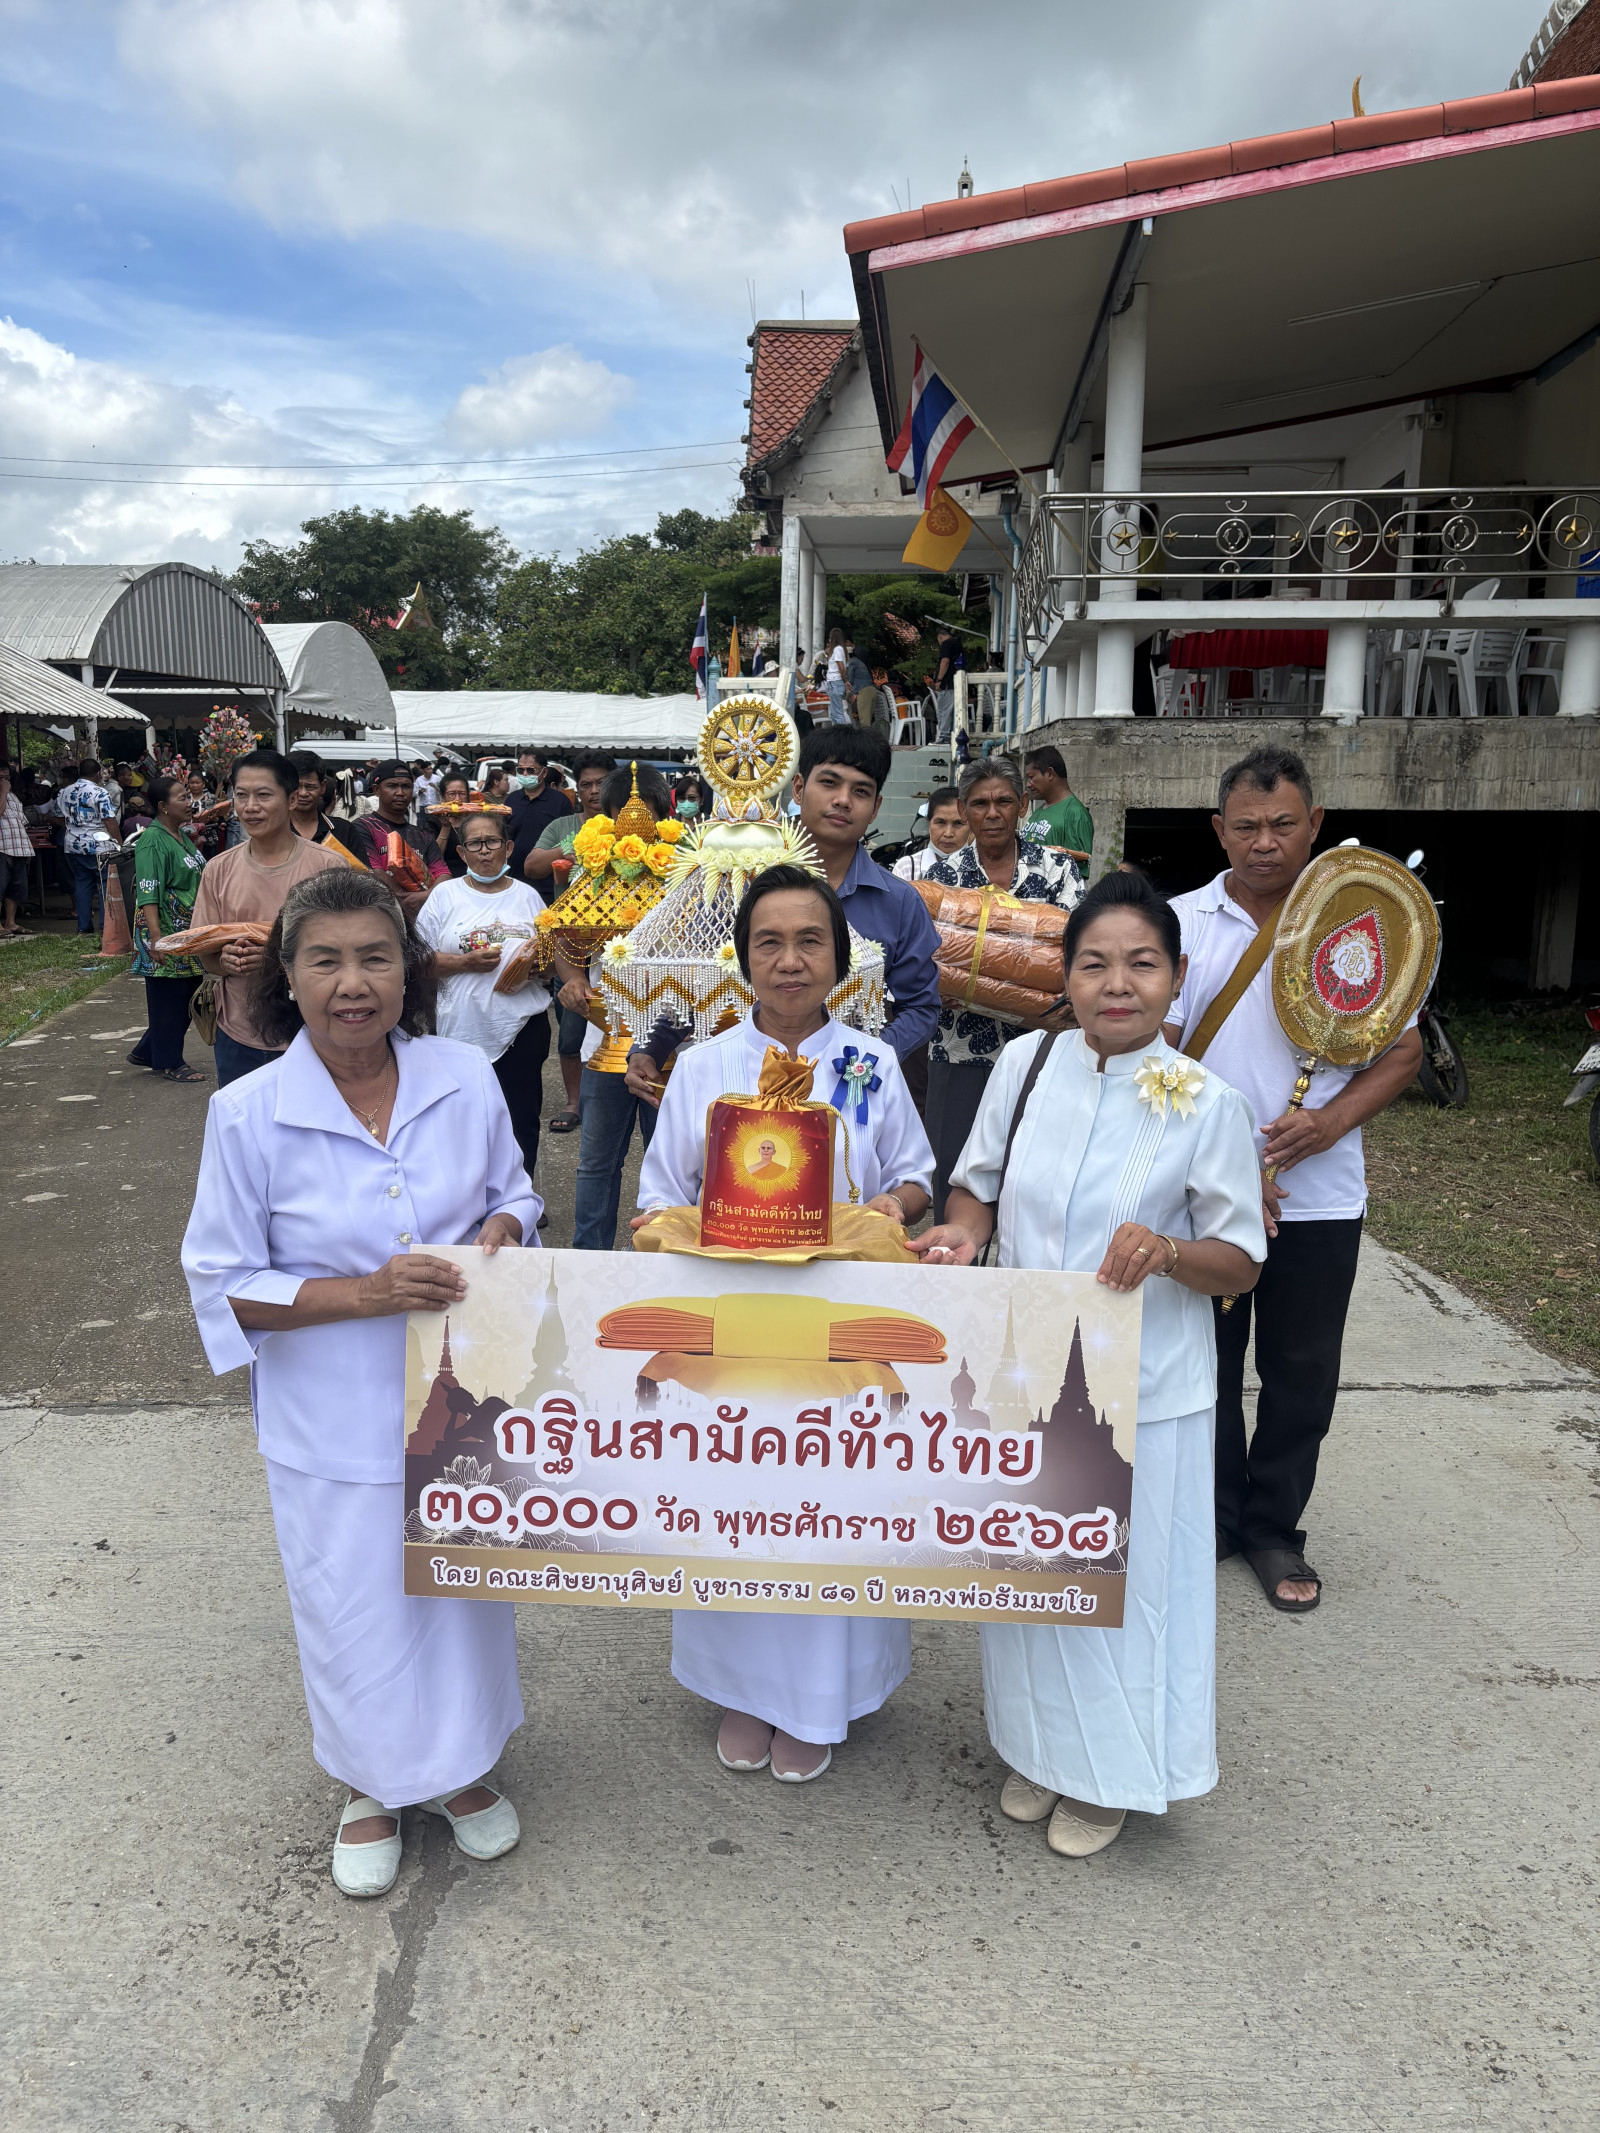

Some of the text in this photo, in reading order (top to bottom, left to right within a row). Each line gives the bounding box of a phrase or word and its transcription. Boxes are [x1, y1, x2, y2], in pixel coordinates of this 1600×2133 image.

[709, 1198, 823, 1220] กฐินสามัคคีทั่วไทย
[738, 1222, 749, 1232] วัด
[751, 1225, 796, 1236] พุทธศักราช
[501, 1393, 1036, 1478] กฐินสามัคคีทั่วไทย
[426, 1489, 1110, 1552] ๓๐,๐๐๐ วัด พุทธศักราช ๒๕๖๘
[432, 1559, 1097, 1613] โดย คณะศิษยานุศิษย์ บูชาธรรม ๘๑ ปี หลวงพ่อธัมมชโย
